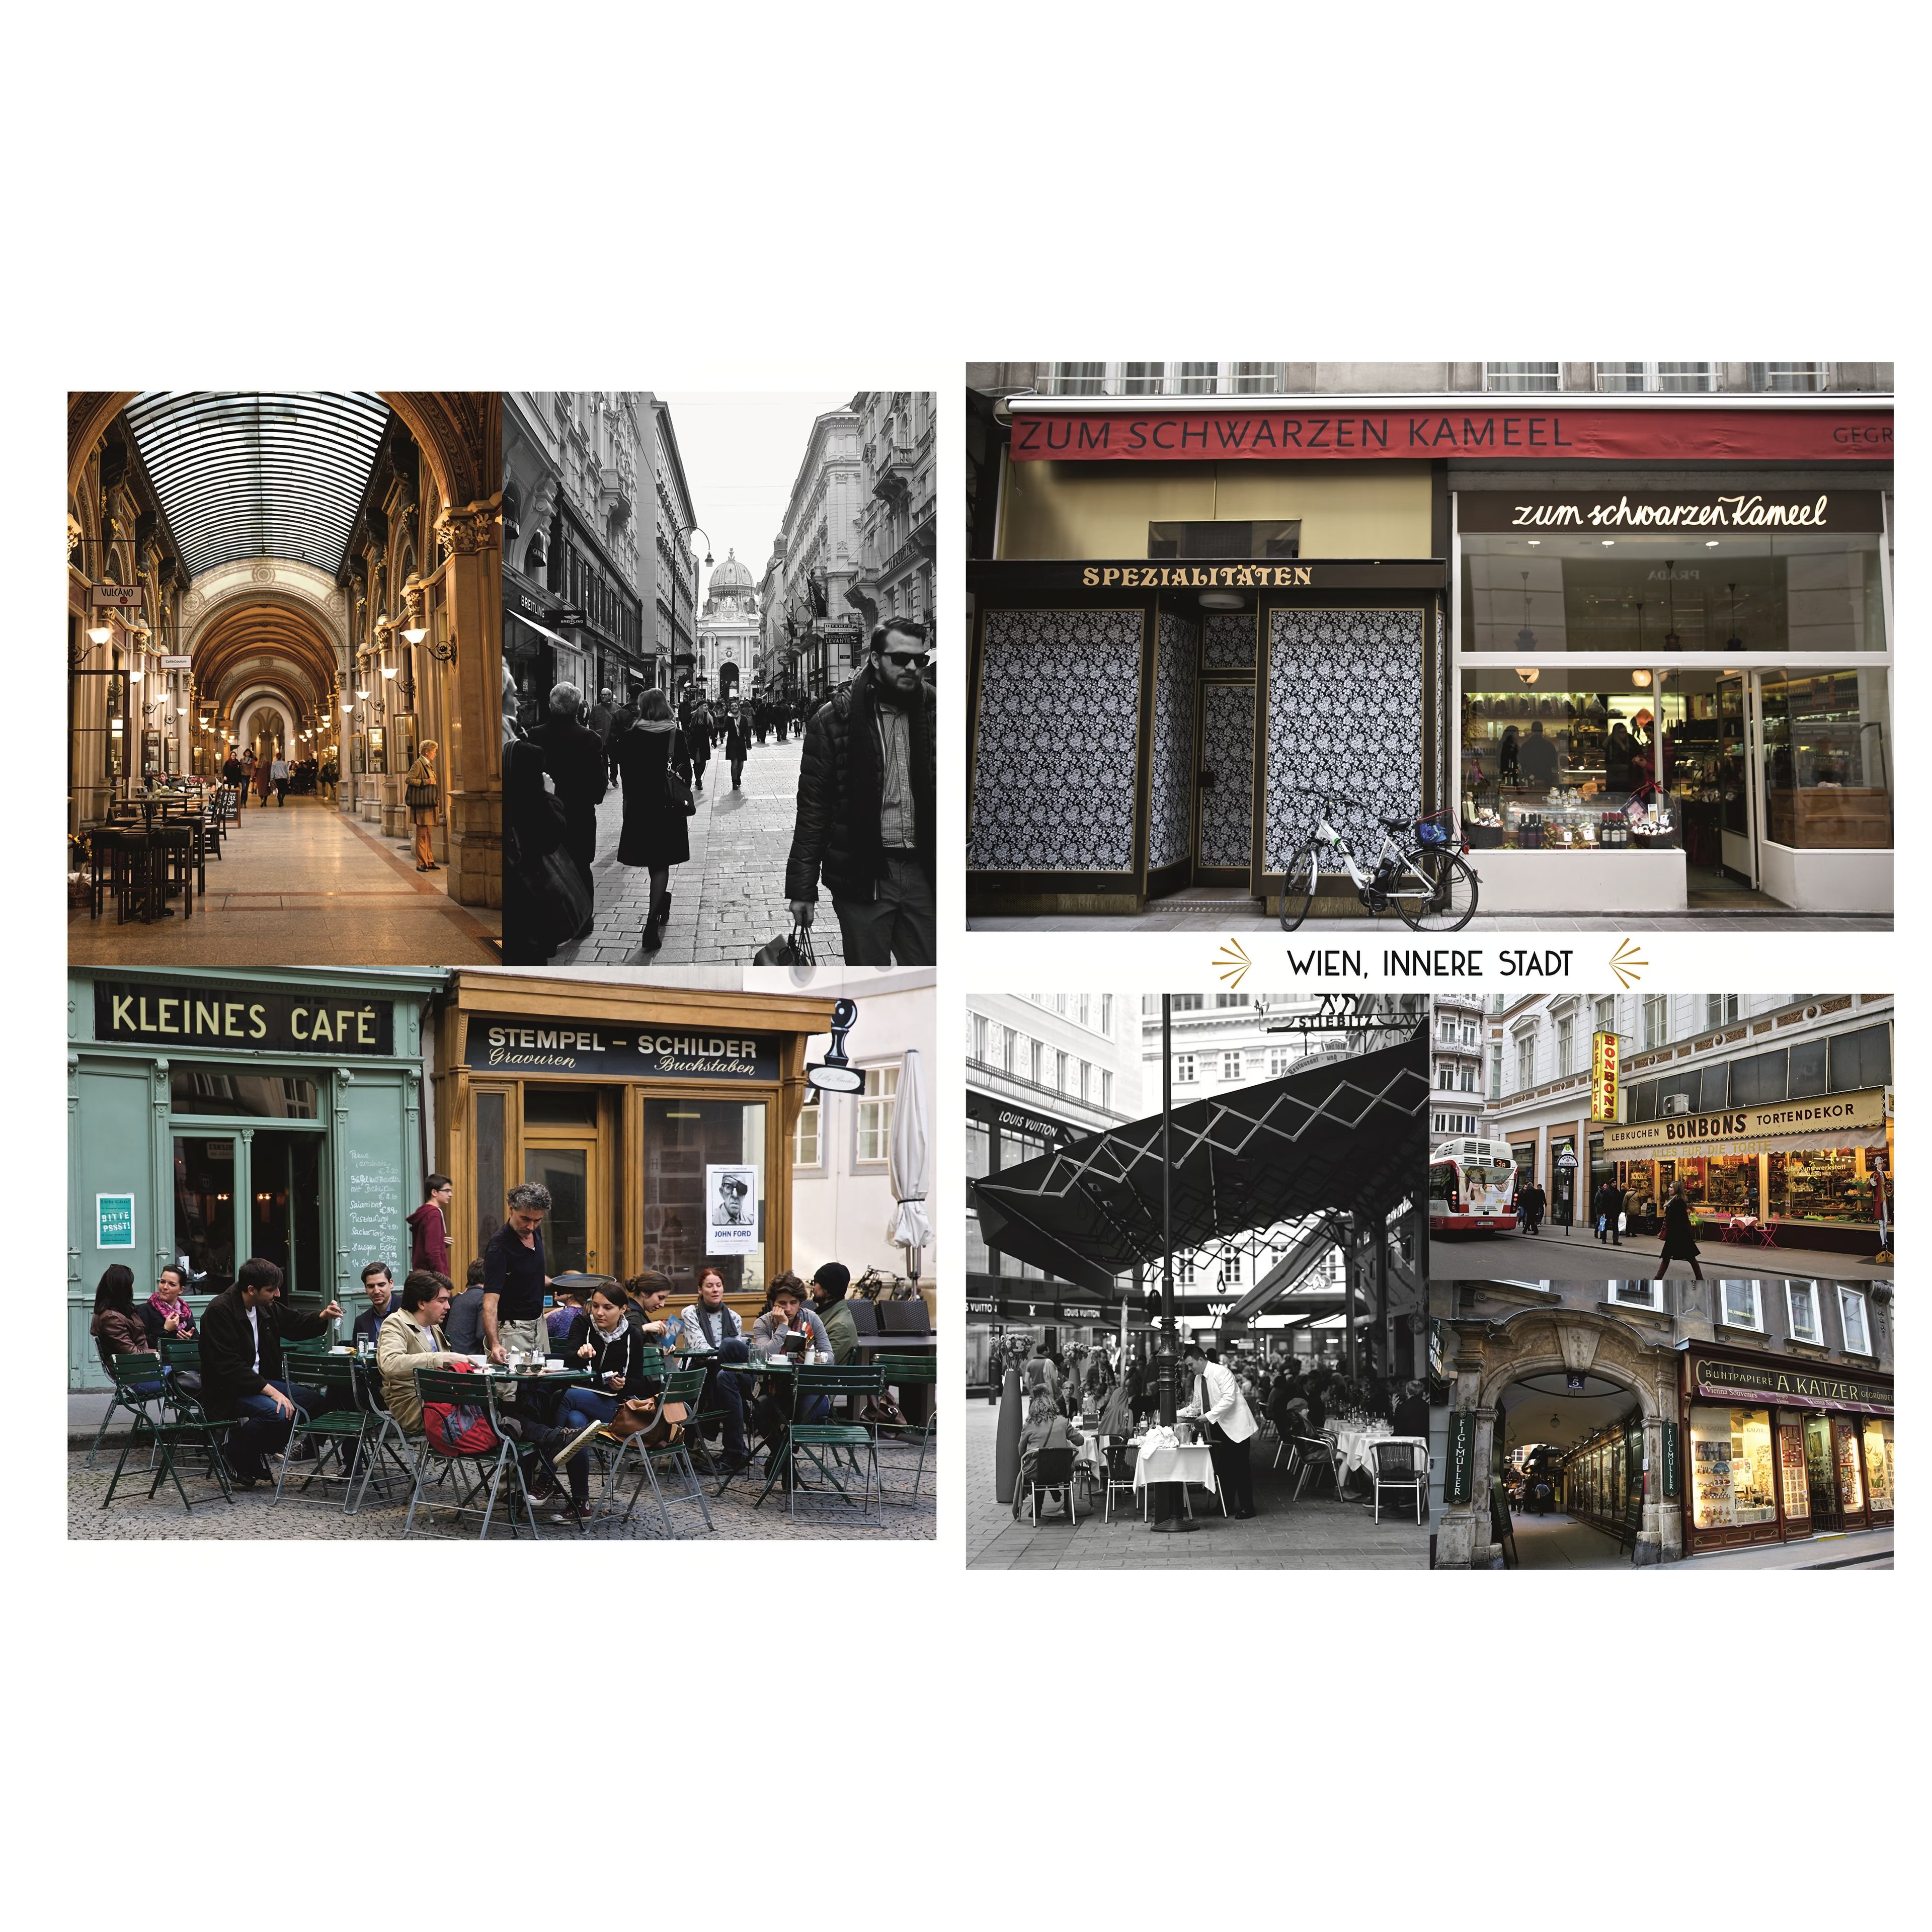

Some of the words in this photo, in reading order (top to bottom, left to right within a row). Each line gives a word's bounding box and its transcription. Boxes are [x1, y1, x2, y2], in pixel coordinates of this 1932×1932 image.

[1019, 421, 1110, 449] ZUM
[1128, 420, 1388, 449] SCHWARZEN
[1409, 418, 1572, 446] KAMEEL
[1833, 427, 1894, 443] GEGR
[1512, 505, 1583, 525] zum
[1587, 496, 1729, 525] schwarzen
[1719, 495, 1827, 525] Kameel
[1083, 565, 1312, 586] SPEZIALITÄTEN
[101, 587, 133, 597] VULCANO
[521, 595, 545, 618] BREITLING
[113, 995, 267, 1038] KLEINES
[291, 1005, 376, 1044] CAFÉ
[1299, 1015, 1373, 1028] STIEBITZ
[489, 1027, 606, 1052] STEMPEL
[638, 1035, 756, 1058] SCHILDER
[489, 1048, 576, 1069] Gravuren
[654, 1056, 756, 1076] Buchstaben
[1288, 1057, 1319, 1075] Restaurant
[1604, 1034, 1616, 1118] BONBONS
[998, 1110, 1024, 1127] LOUIS
[1025, 1118, 1058, 1137] VUITTON
[1612, 1128, 1660, 1141] LEBKUCHEN
[1666, 1113, 1748, 1140] BONBONS
[1756, 1103, 1855, 1125] TORTENDEKOR
[1651, 1147, 1677, 1157] ALLES
[1682, 1144, 1702, 1157] FÜR
[1707, 1143, 1726, 1155] DIE
[1732, 1140, 1772, 1153] TORTE
[102, 1212, 129, 1223] BITTE
[103, 1222, 130, 1232] PSSST!
[1706, 1370, 1773, 1386] BUNTPAPIERE
[1706, 1386, 1728, 1395] Vienna
[1455, 1419, 1466, 1495] FIGLMÜLLER
